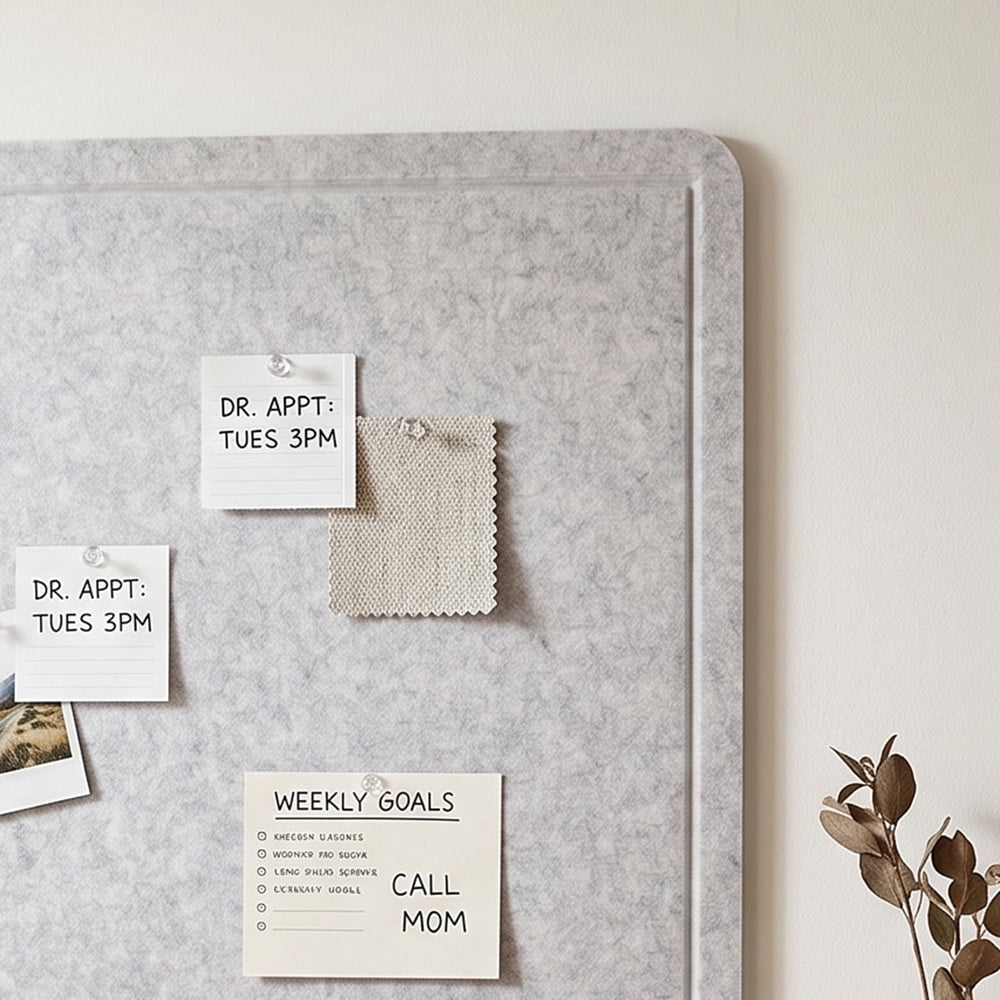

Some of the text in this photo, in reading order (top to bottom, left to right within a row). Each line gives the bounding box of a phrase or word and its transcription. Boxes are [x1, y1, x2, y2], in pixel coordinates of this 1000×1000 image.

[220, 395, 335, 418] DR. APPT:
[218, 427, 338, 450] TUES 3PM
[32, 578, 147, 601] DR. APPT:
[31, 611, 153, 634] TUES 3PM
[273, 790, 455, 813] WEEKLY GOALS
[391, 872, 461, 897] CALL
[402, 910, 467, 934] MOM
